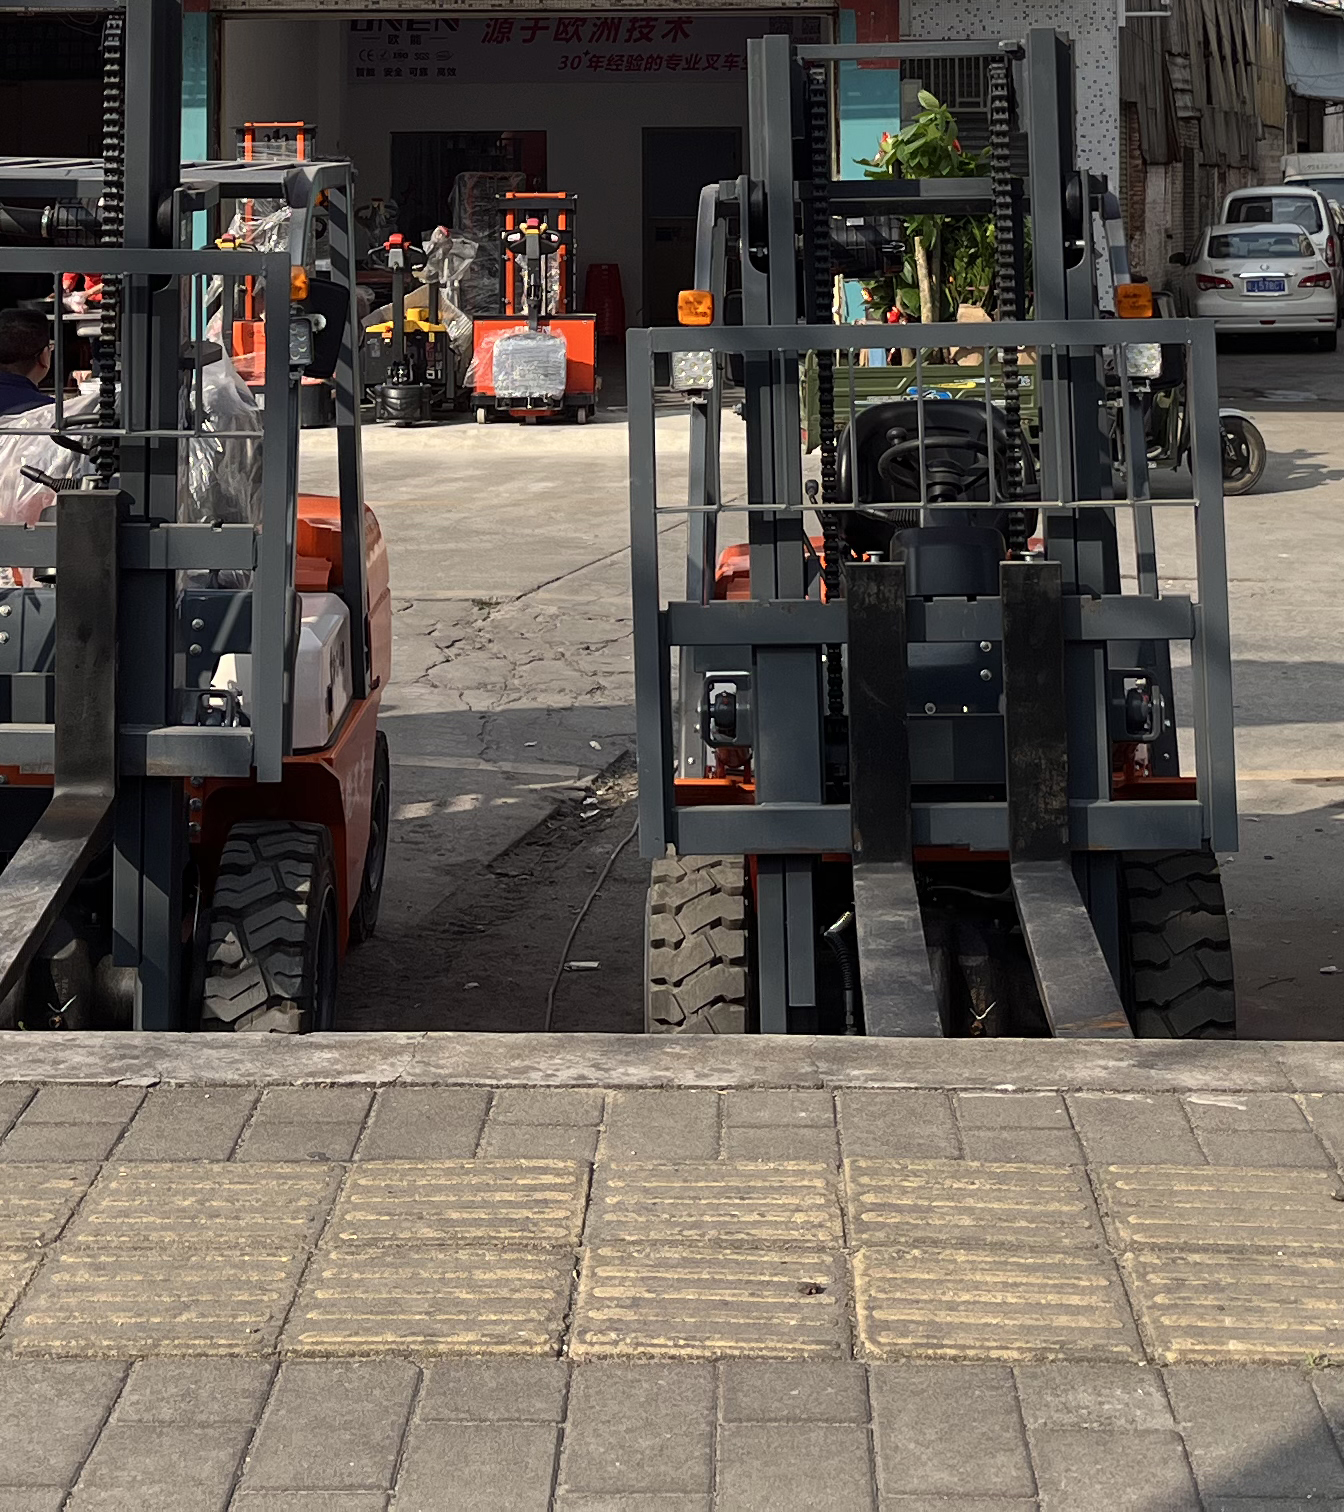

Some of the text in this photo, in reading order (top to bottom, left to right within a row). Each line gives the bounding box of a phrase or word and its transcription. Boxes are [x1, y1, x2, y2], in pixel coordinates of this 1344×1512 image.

[387, 34, 423, 46] 欧能
[481, 18, 695, 45] 源于欧洲技术
